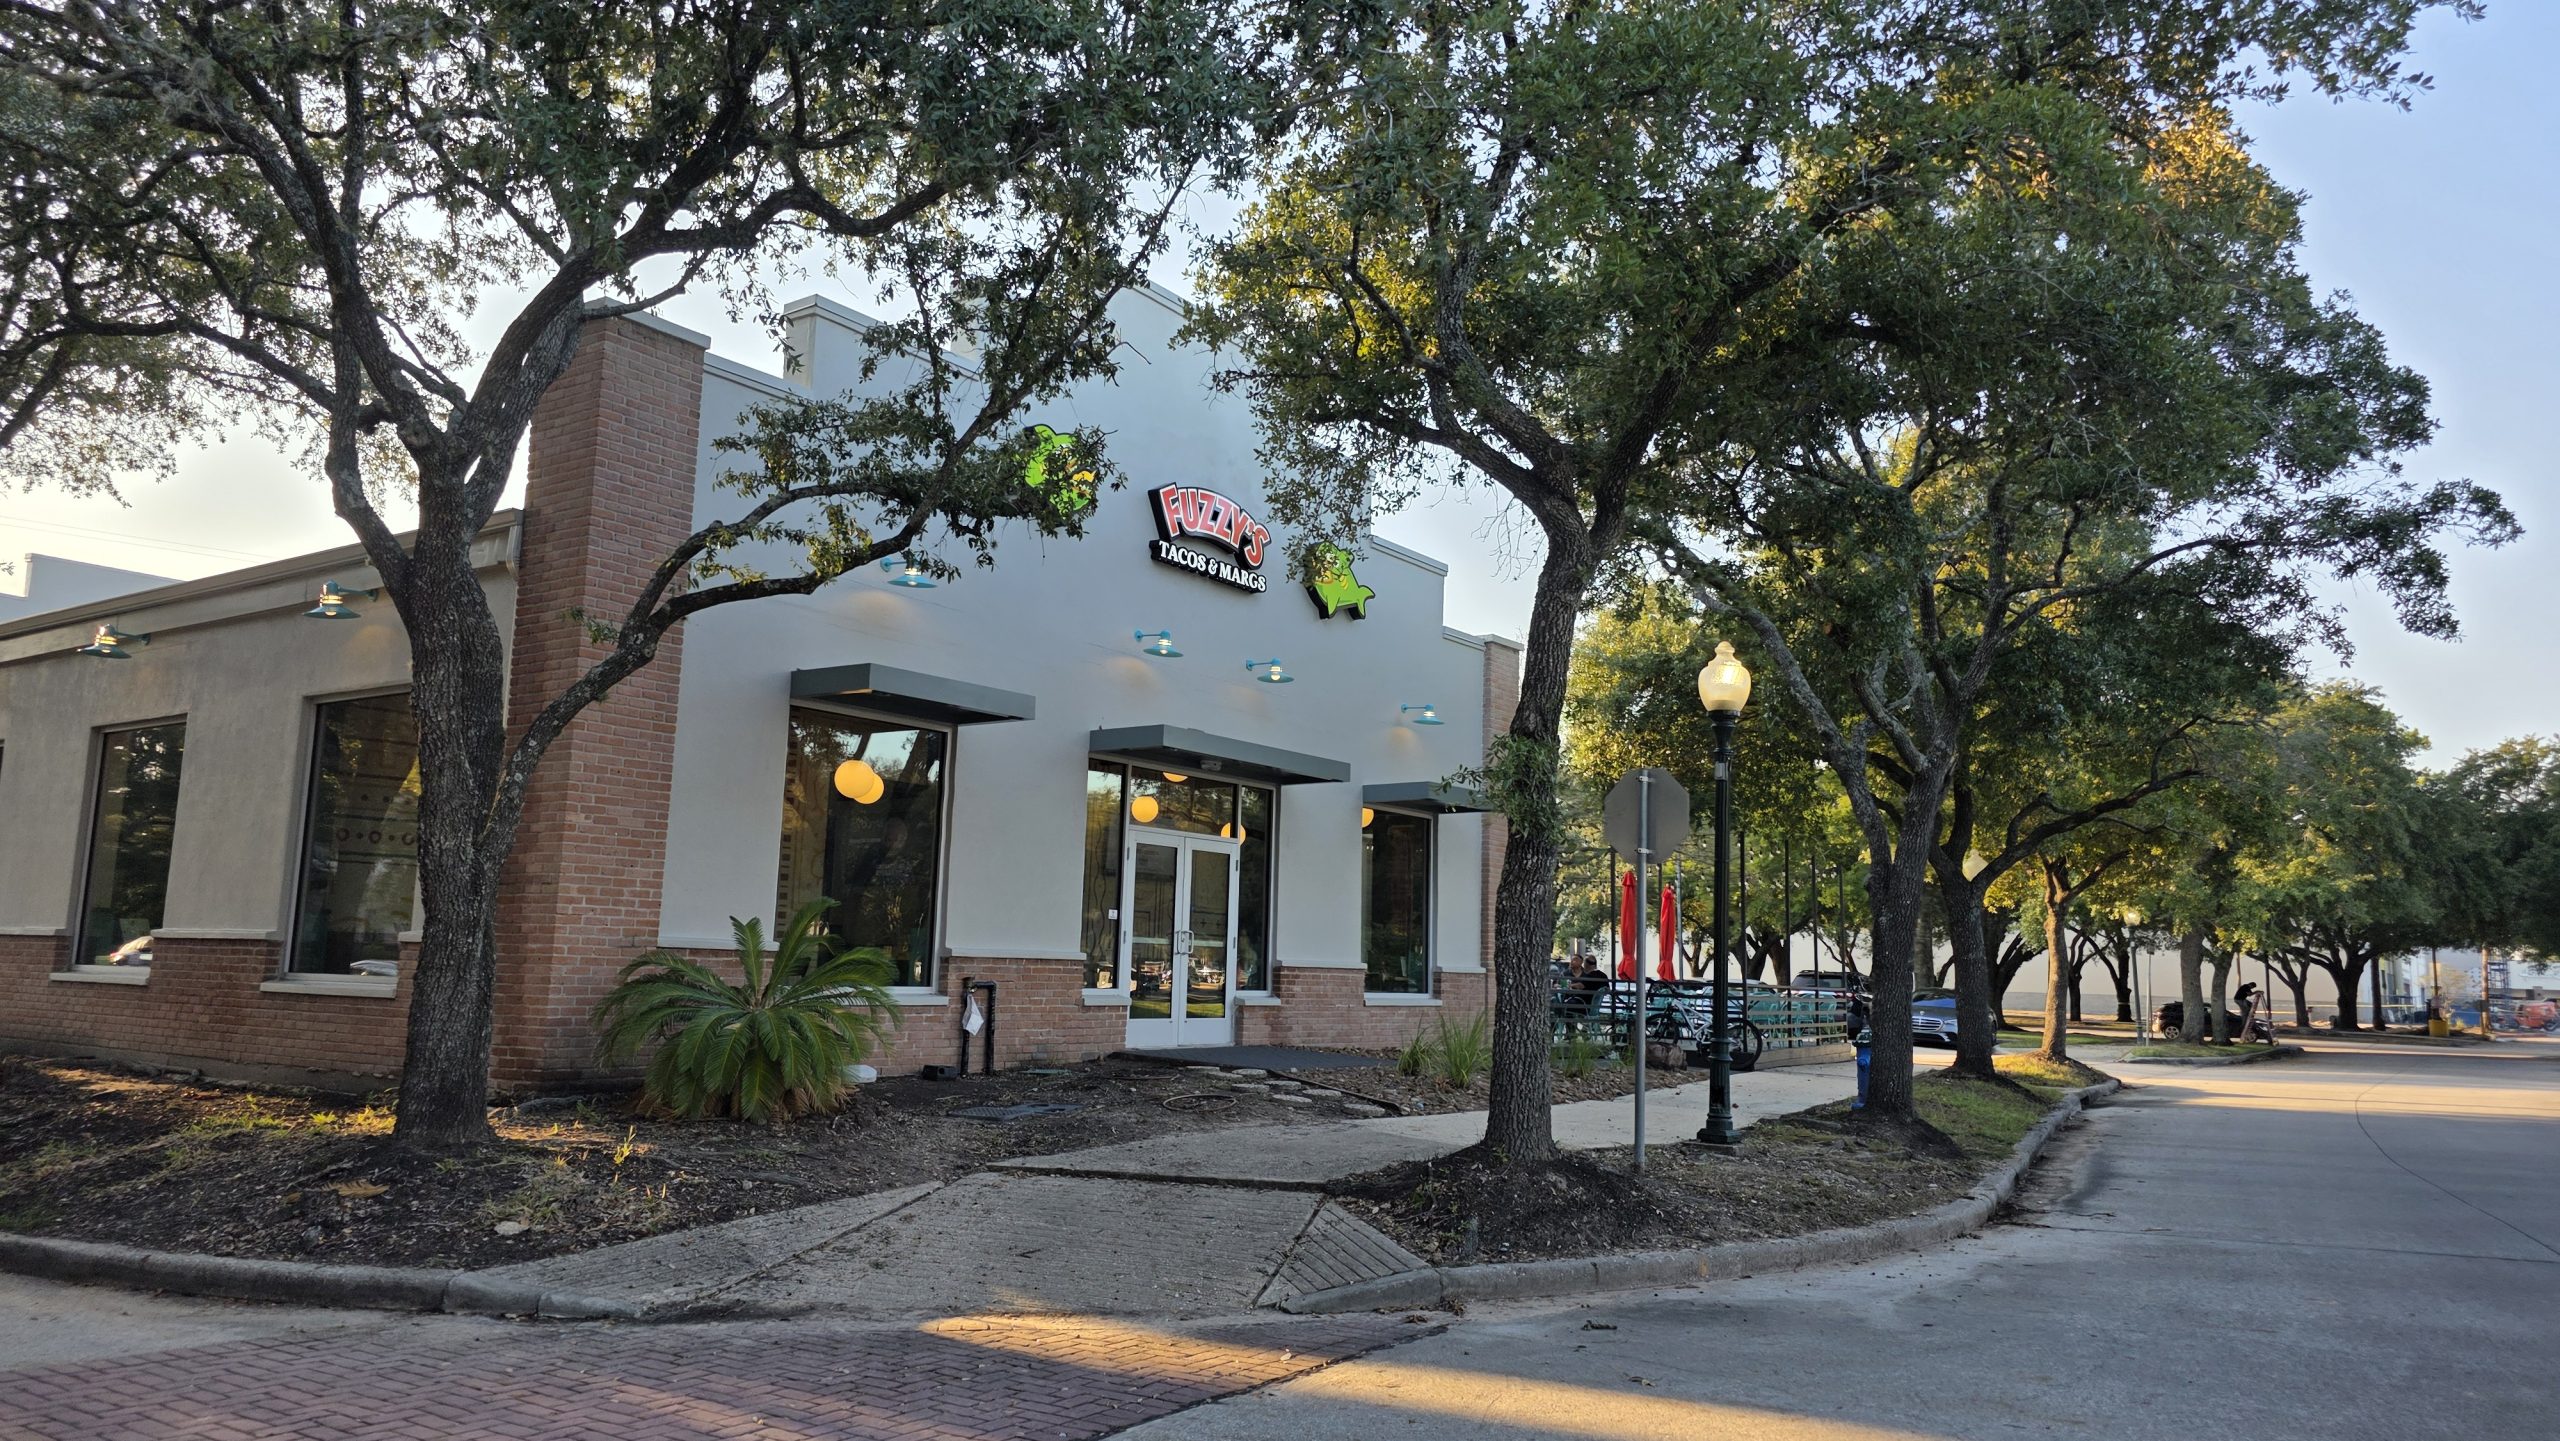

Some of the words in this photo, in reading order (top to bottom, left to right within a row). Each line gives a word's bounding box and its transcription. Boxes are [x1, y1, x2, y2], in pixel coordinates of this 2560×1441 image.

[1160, 484, 1270, 567] FUZZY'S
[1159, 541, 1206, 571] TACOS
[1208, 558, 1218, 575] &
[1219, 562, 1266, 592] MARGS
